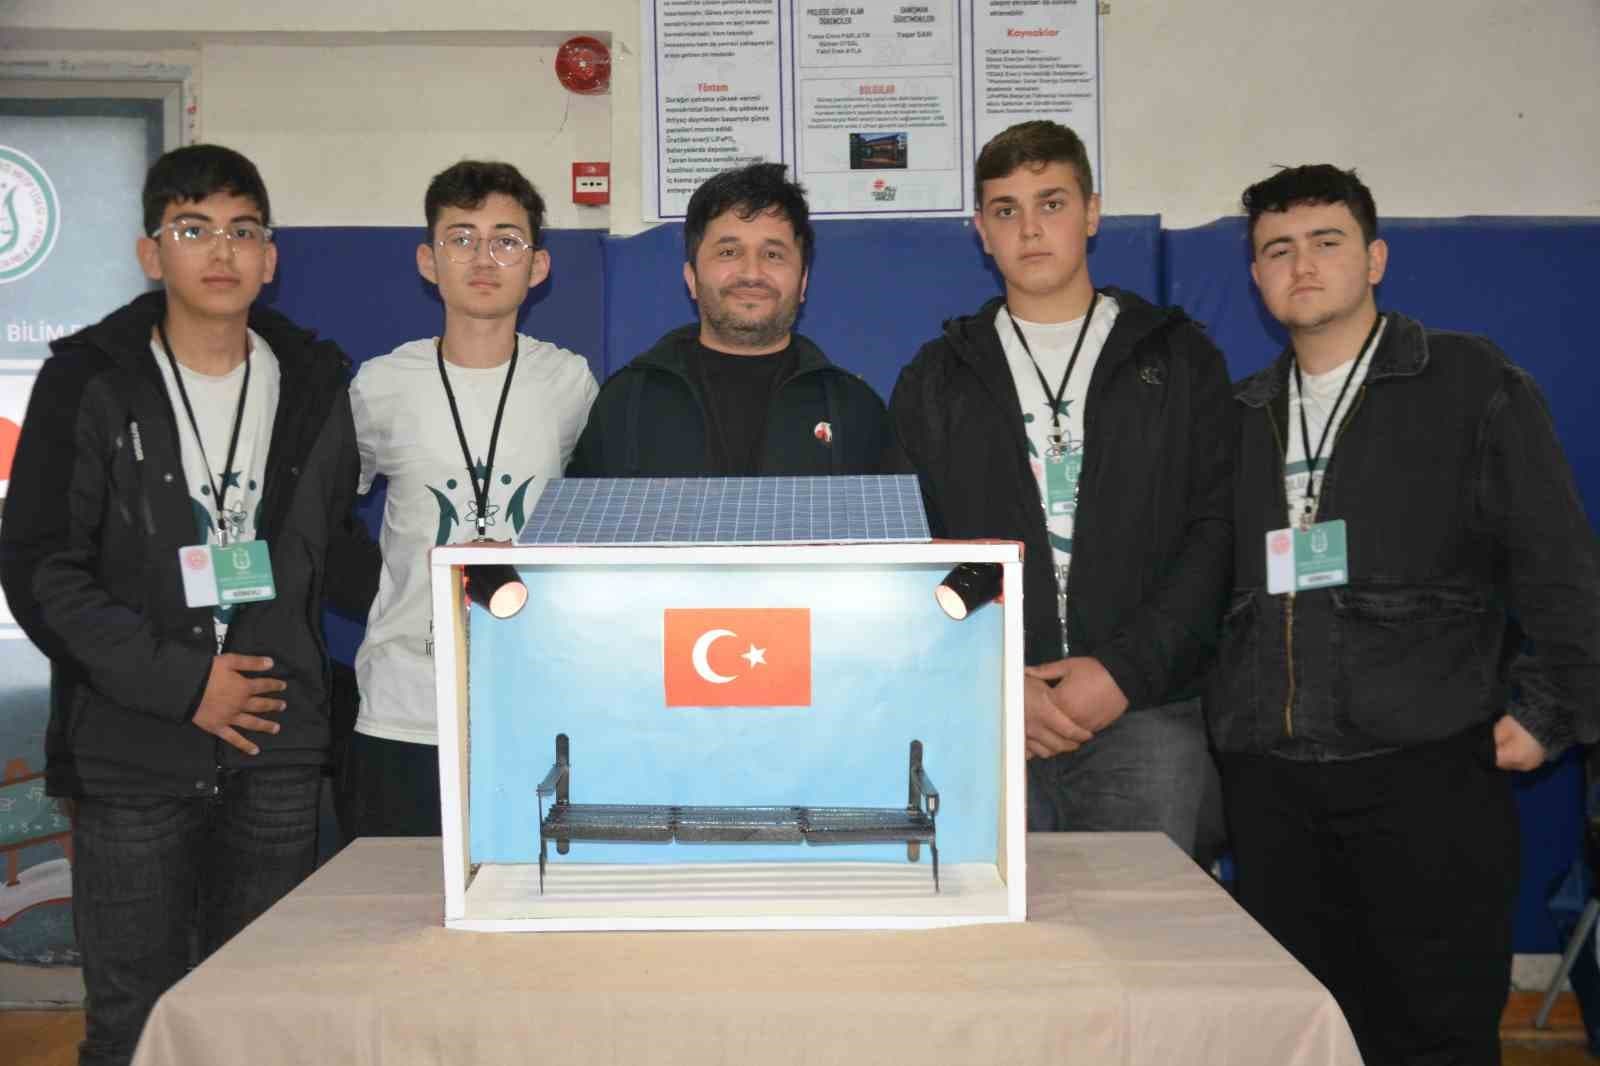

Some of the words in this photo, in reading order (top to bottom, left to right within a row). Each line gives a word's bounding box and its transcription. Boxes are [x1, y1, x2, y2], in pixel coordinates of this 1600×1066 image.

[1008, 27, 1060, 39] Kaynaklar
[697, 82, 729, 93] Yöntem
[8, 320, 65, 342] BİLİM
